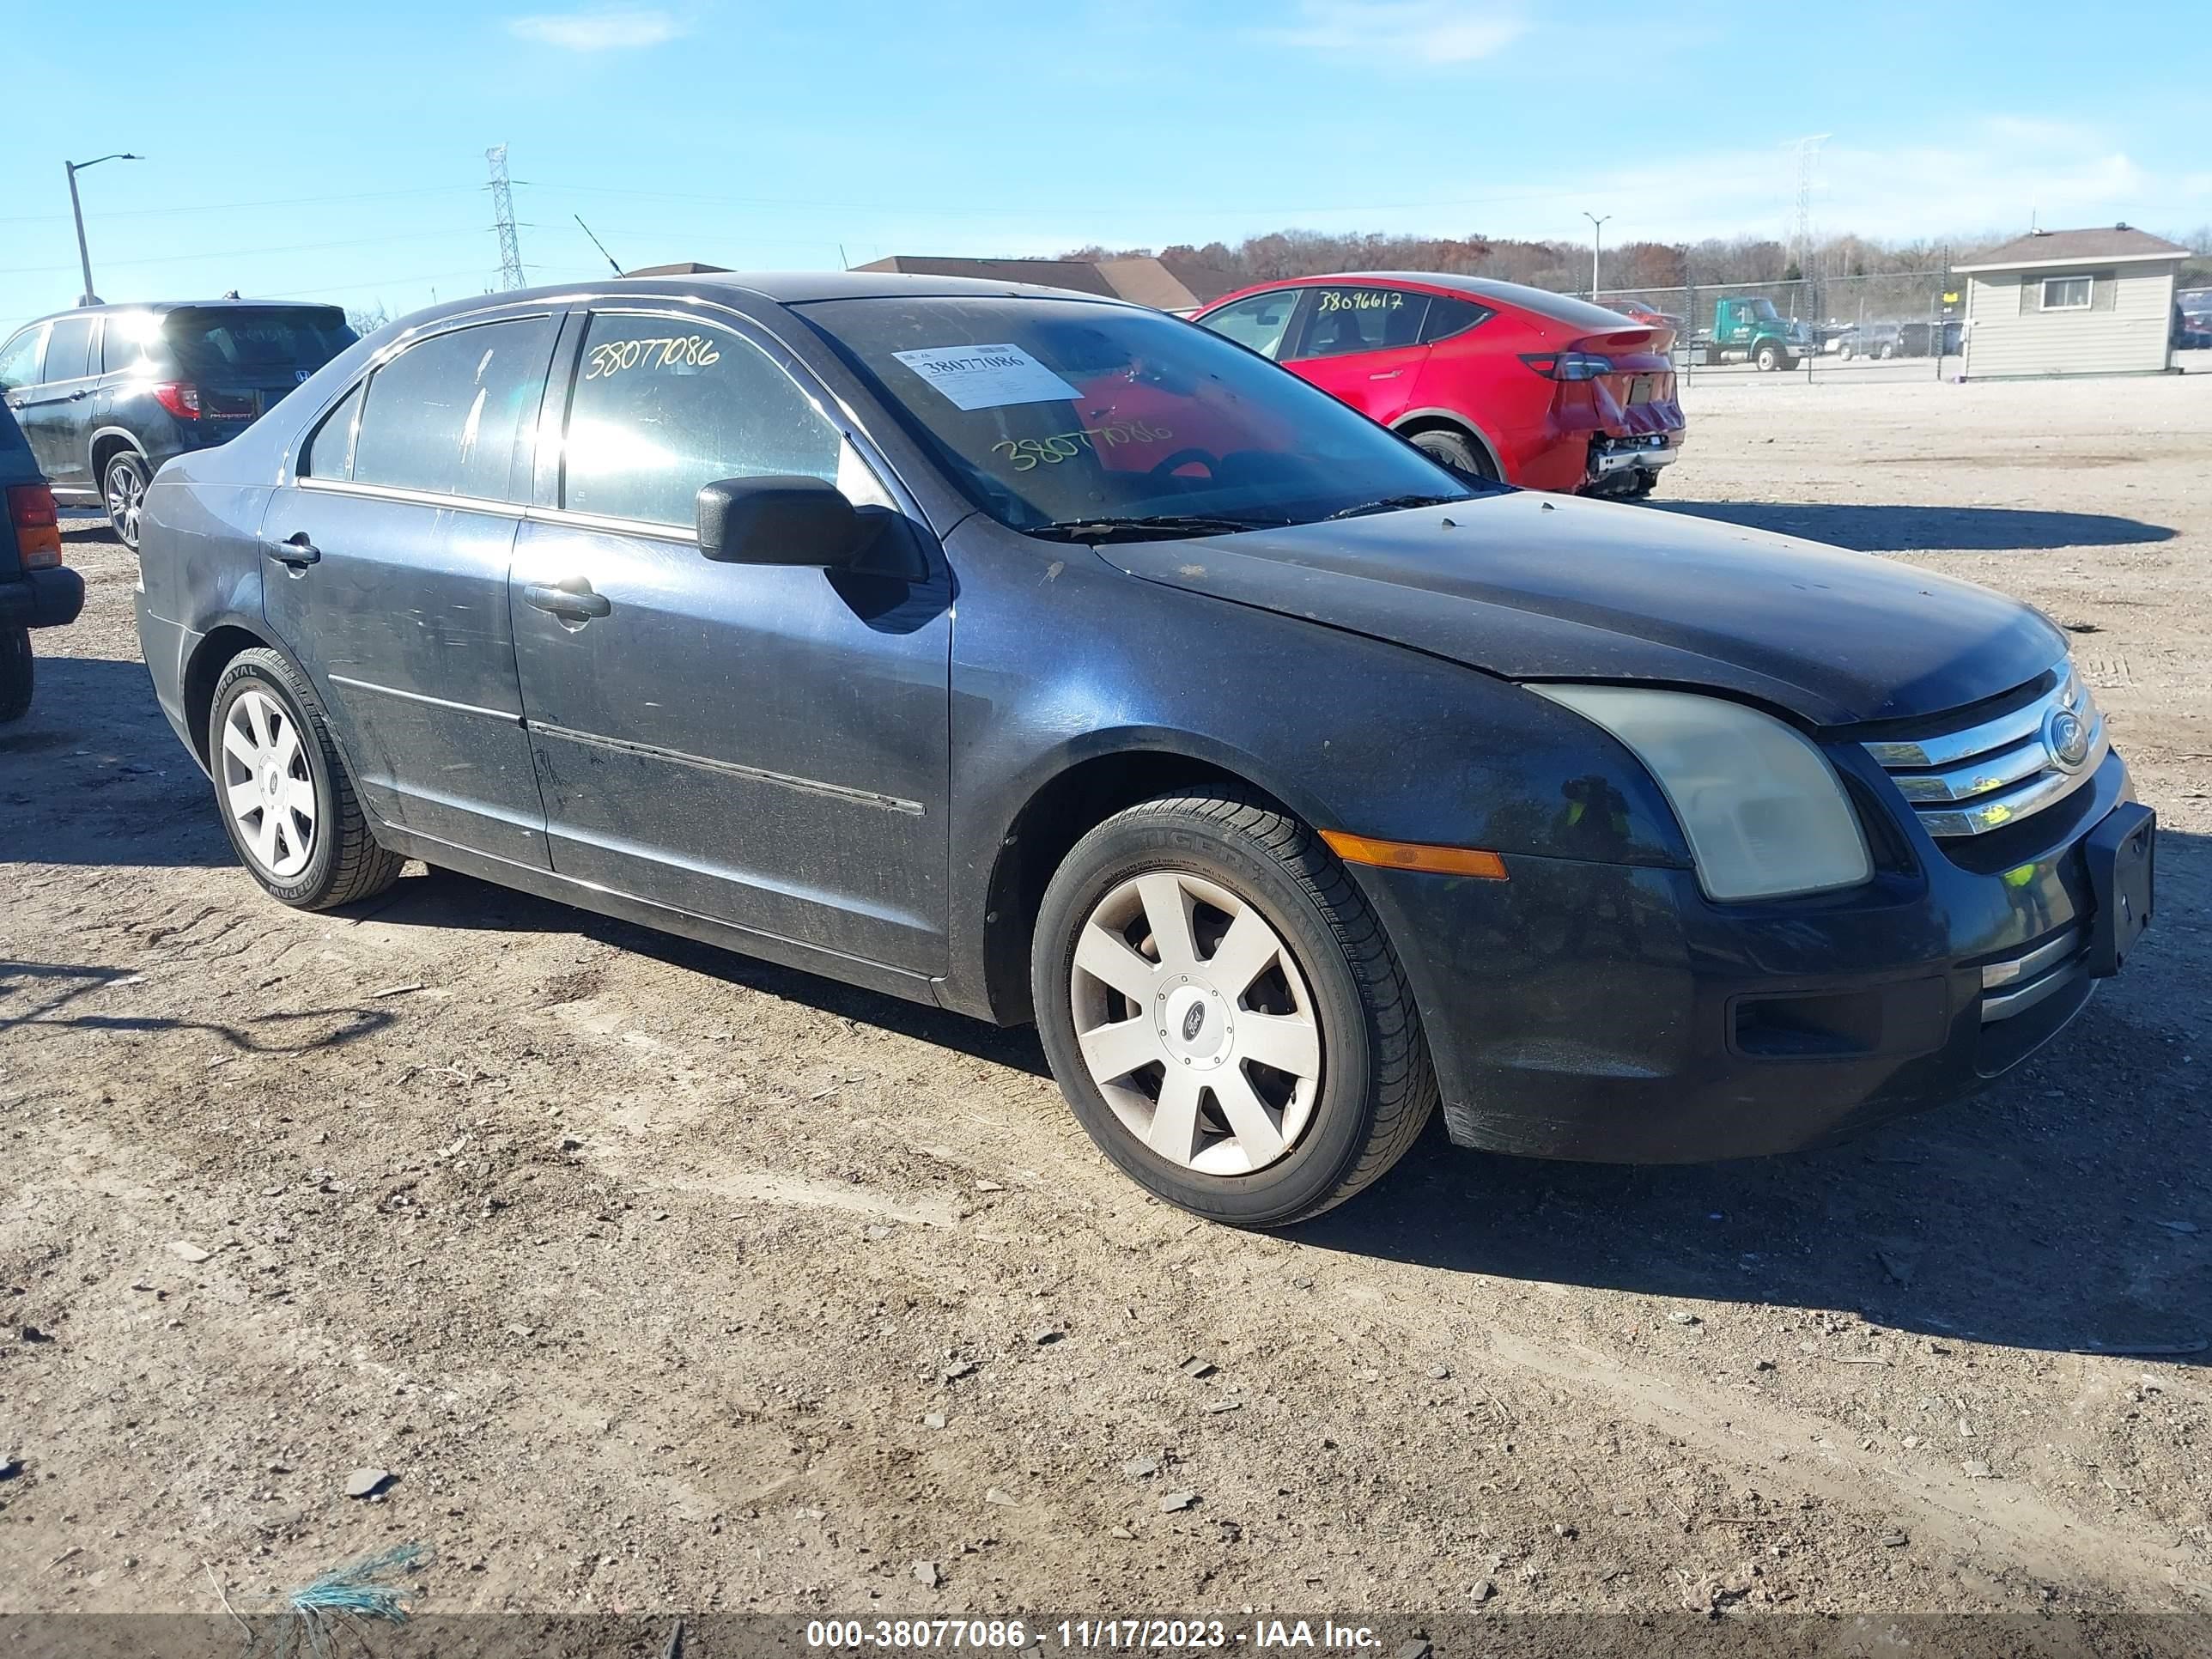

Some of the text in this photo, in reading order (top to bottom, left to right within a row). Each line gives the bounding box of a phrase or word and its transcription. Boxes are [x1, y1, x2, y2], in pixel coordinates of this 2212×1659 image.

[1318, 291, 1404, 312] 38096617
[585, 335, 720, 380] 38077086
[922, 356, 1024, 374] 38077086
[991, 420, 1173, 472] 38077086
